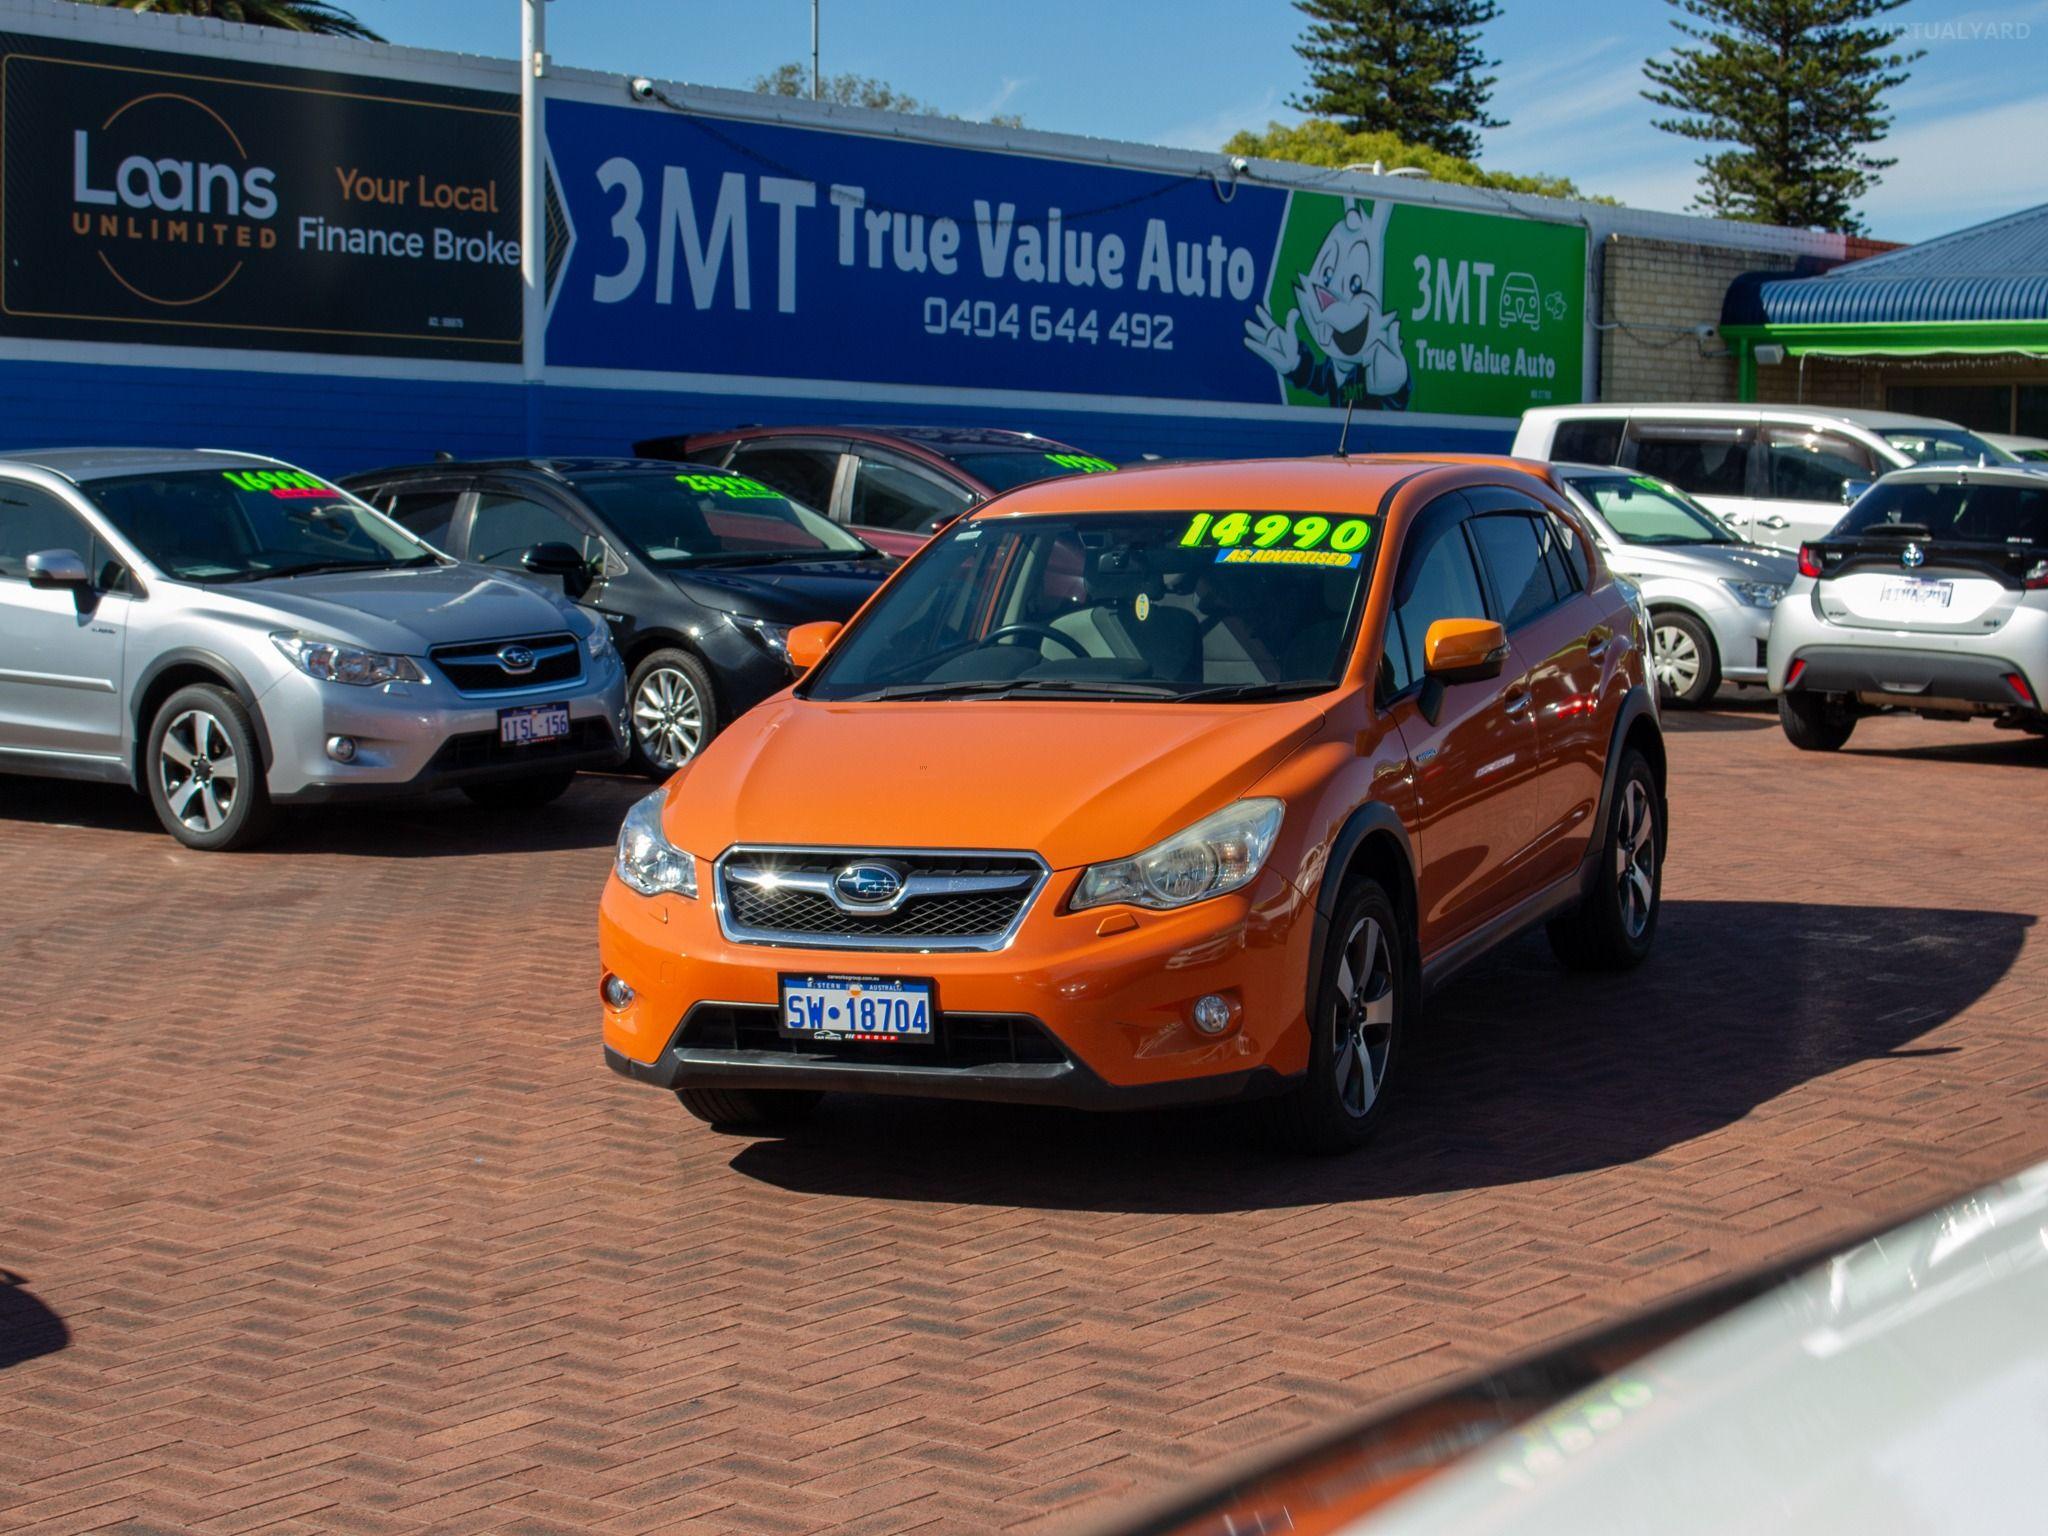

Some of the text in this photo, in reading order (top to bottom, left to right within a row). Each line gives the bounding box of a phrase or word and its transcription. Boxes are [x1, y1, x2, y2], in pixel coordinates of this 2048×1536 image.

[74, 129, 278, 219] Loans
[335, 166, 499, 213] Your Local
[72, 212, 277, 249] UNLIMITED
[298, 215, 424, 258] Finance
[593, 157, 816, 313] 3MT
[829, 184, 1255, 300] True Value Auto
[1411, 254, 1495, 326] 3MT
[924, 297, 1173, 350] 0404 644 492
[1415, 339, 1556, 379] True Value Auto
[221, 470, 327, 492] 16990
[1179, 512, 1371, 552] 14990
[1223, 549, 1353, 567] AS ADVERTISED
